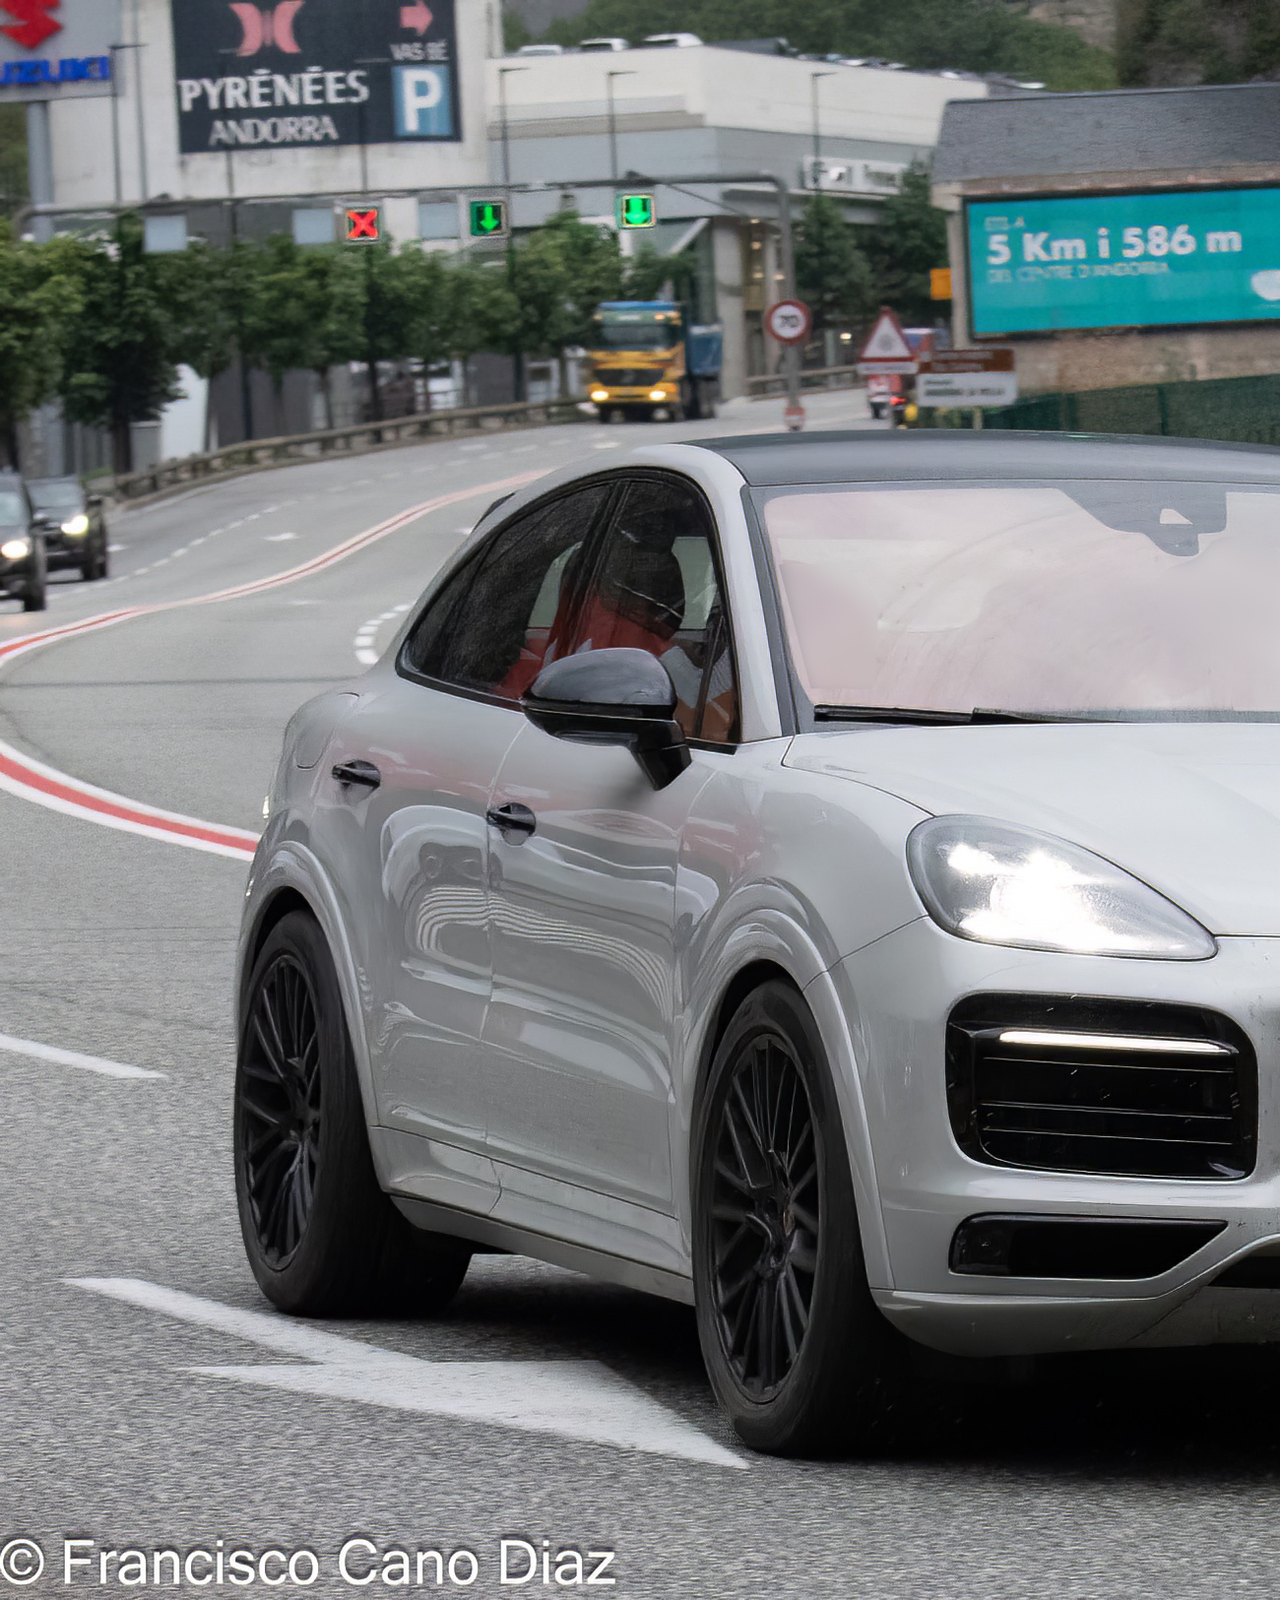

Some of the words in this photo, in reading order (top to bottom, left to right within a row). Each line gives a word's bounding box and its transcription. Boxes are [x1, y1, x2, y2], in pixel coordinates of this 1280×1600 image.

[402, 68, 442, 132] P
[208, 115, 340, 147] ANDORRA
[986, 233, 1012, 265] 5
[1022, 232, 1087, 262] Km
[1097, 226, 1111, 259] i
[1121, 224, 1196, 259] 586
[1205, 230, 1242, 253] m
[779, 314, 799, 329] 70
